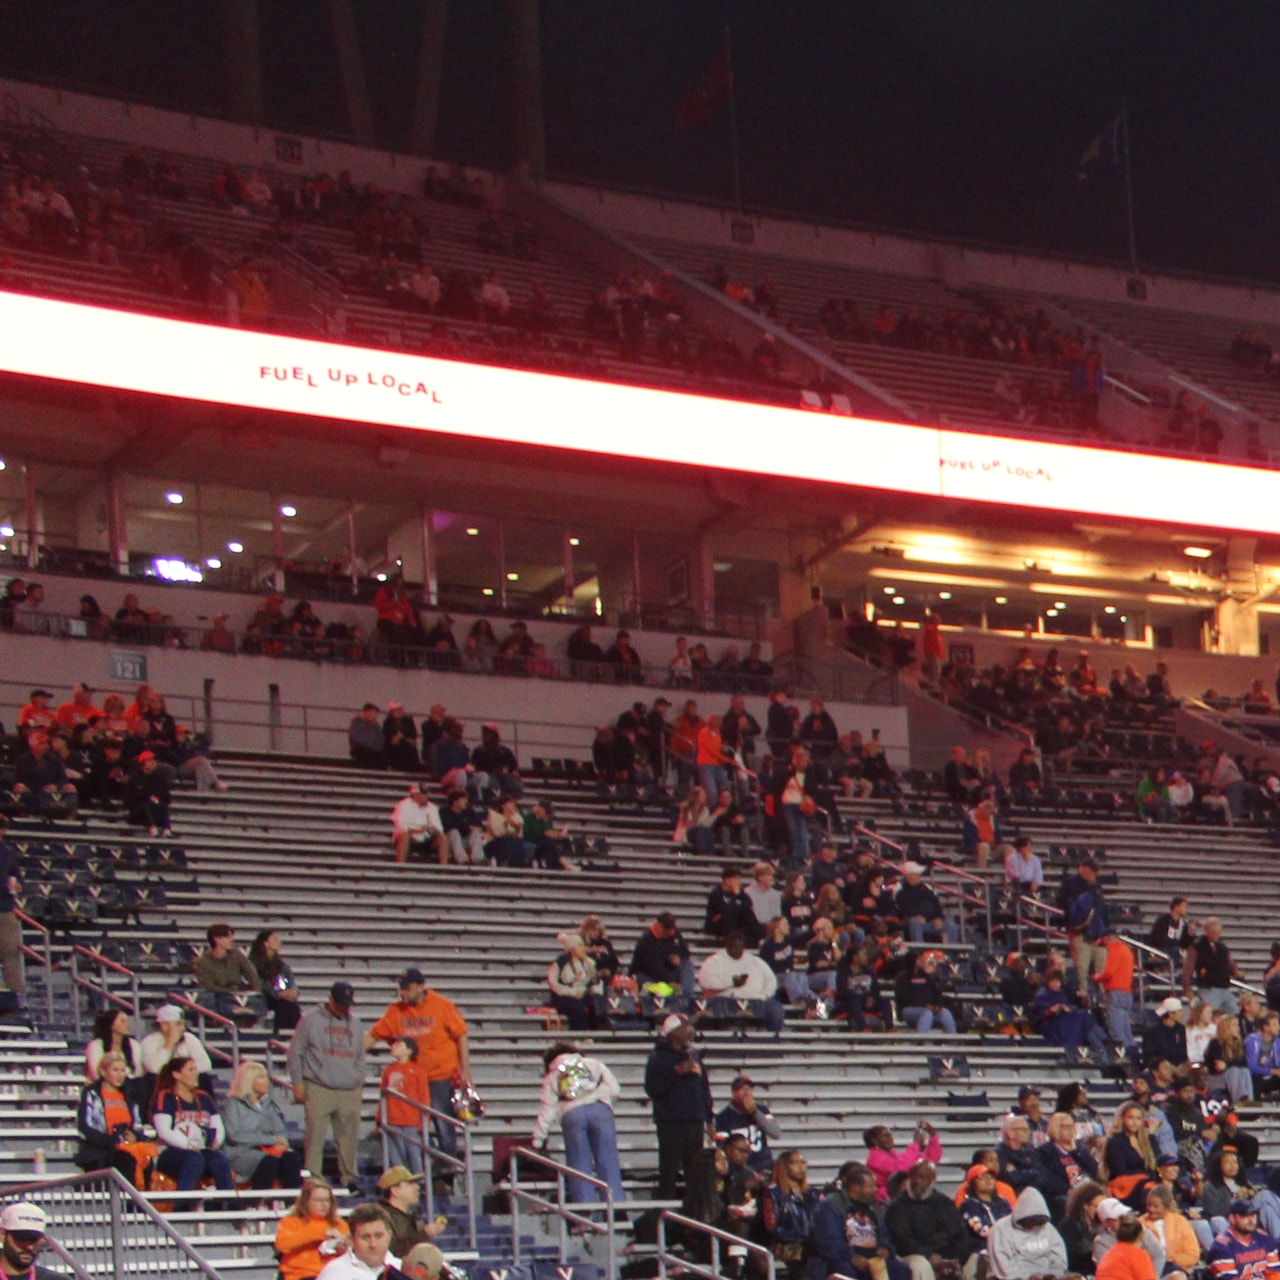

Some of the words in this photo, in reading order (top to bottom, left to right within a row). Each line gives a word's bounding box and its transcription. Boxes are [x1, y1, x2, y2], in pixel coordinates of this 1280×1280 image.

[259, 366, 318, 388] FUEL
[328, 368, 358, 387] UP
[367, 372, 442, 404] LOCAL
[116, 661, 141, 679] 121
